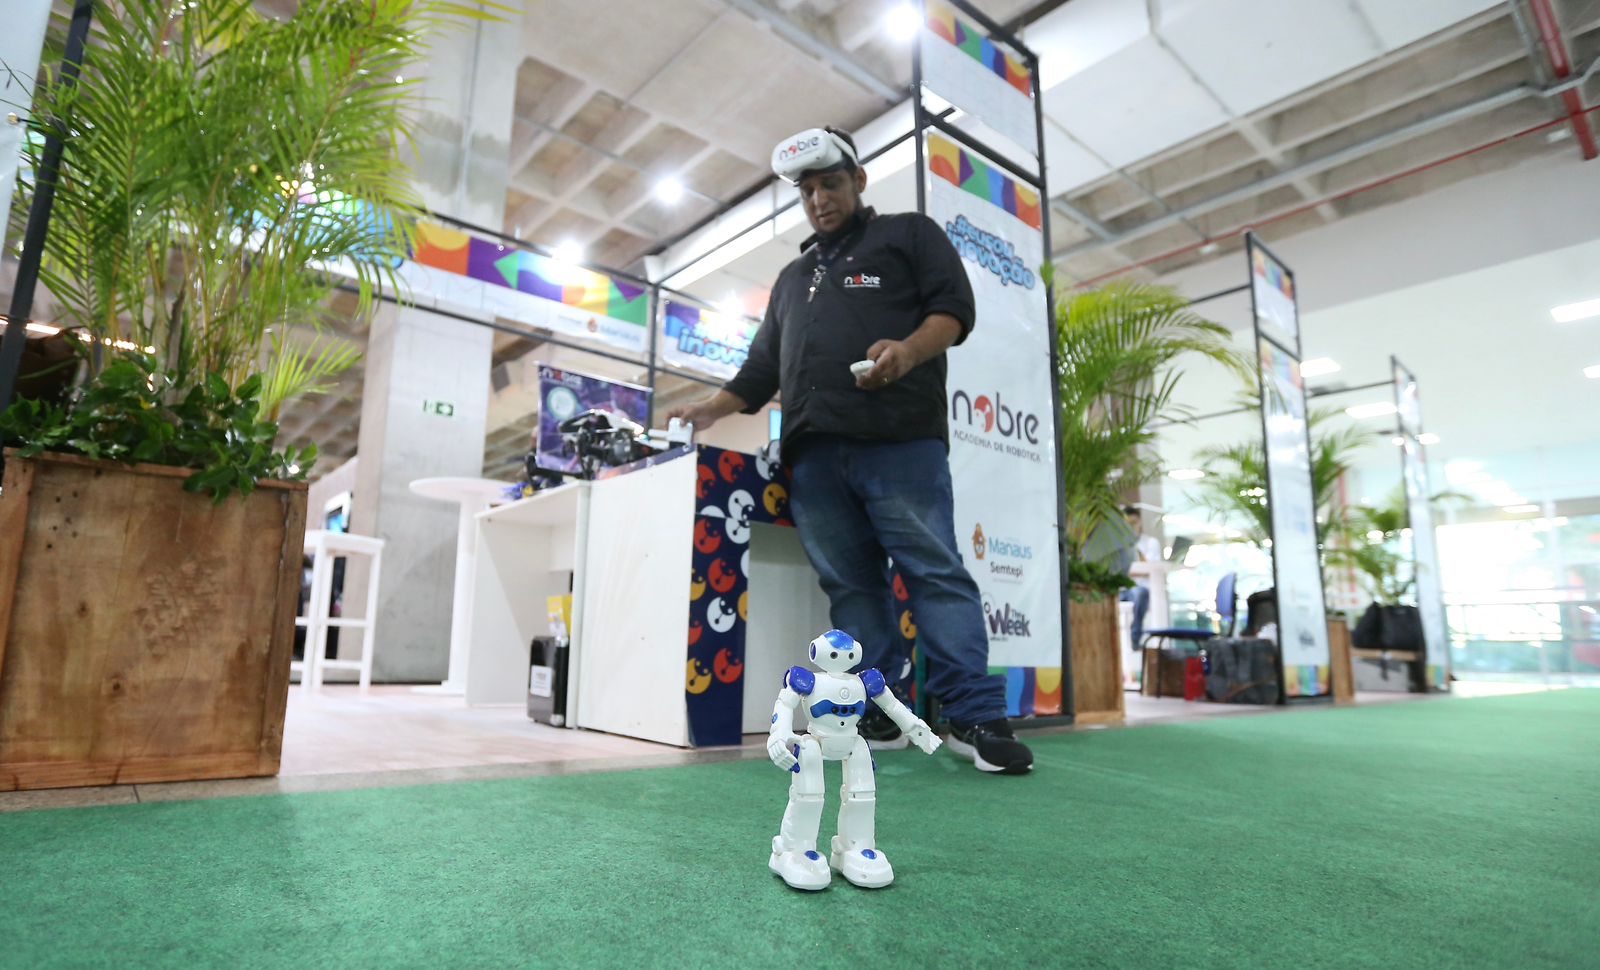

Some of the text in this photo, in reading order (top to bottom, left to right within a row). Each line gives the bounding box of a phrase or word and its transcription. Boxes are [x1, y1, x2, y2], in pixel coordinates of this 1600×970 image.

[994, 441, 1004, 453] DE
[989, 537, 1032, 559] Manaus
[990, 561, 1024, 577] Semtepi
[988, 602, 1031, 638] Week
